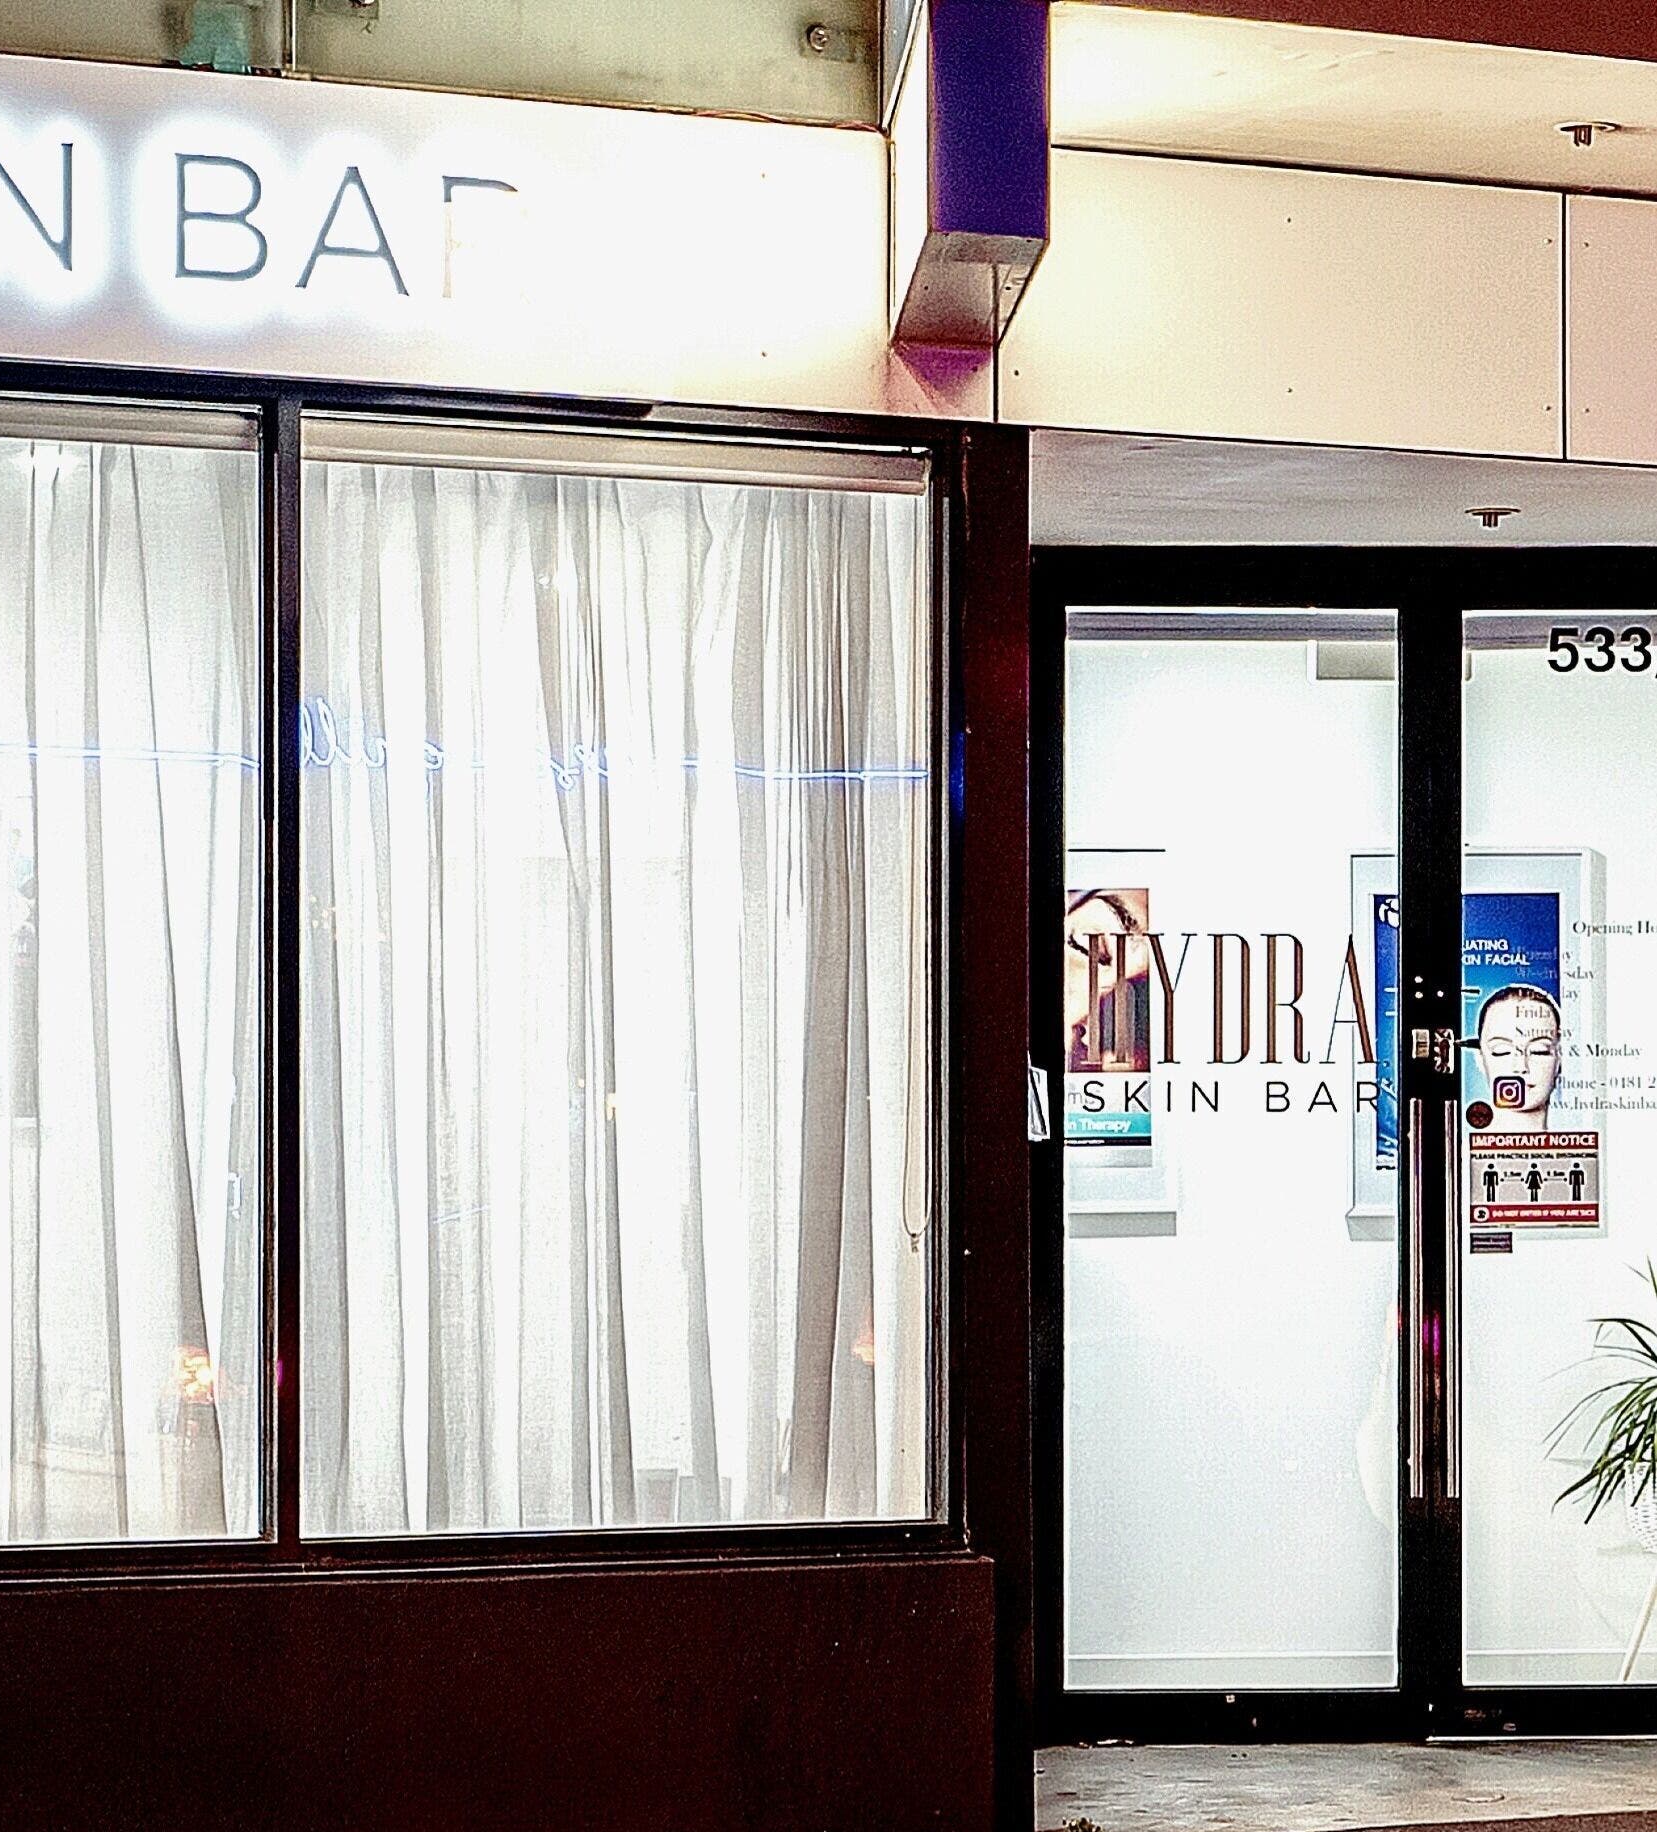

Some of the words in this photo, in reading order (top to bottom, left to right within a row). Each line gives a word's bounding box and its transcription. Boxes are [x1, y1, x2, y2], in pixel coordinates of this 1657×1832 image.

[1547, 626, 1657, 679] 533
[1572, 920, 1633, 938] Opening
[1485, 953, 1531, 966] FACIAL
[1080, 932, 1381, 1065] HYDRA
[1515, 1005, 1558, 1021] Frida
[1586, 1043, 1643, 1059] Monday
[1081, 1080, 1219, 1113] SKIN
[1265, 1080, 1381, 1113] BAR
[1078, 1117, 1132, 1133] Therapy
[1471, 1134, 1546, 1147] IMPORTANT
[1550, 1134, 1596, 1146] NOTICE
